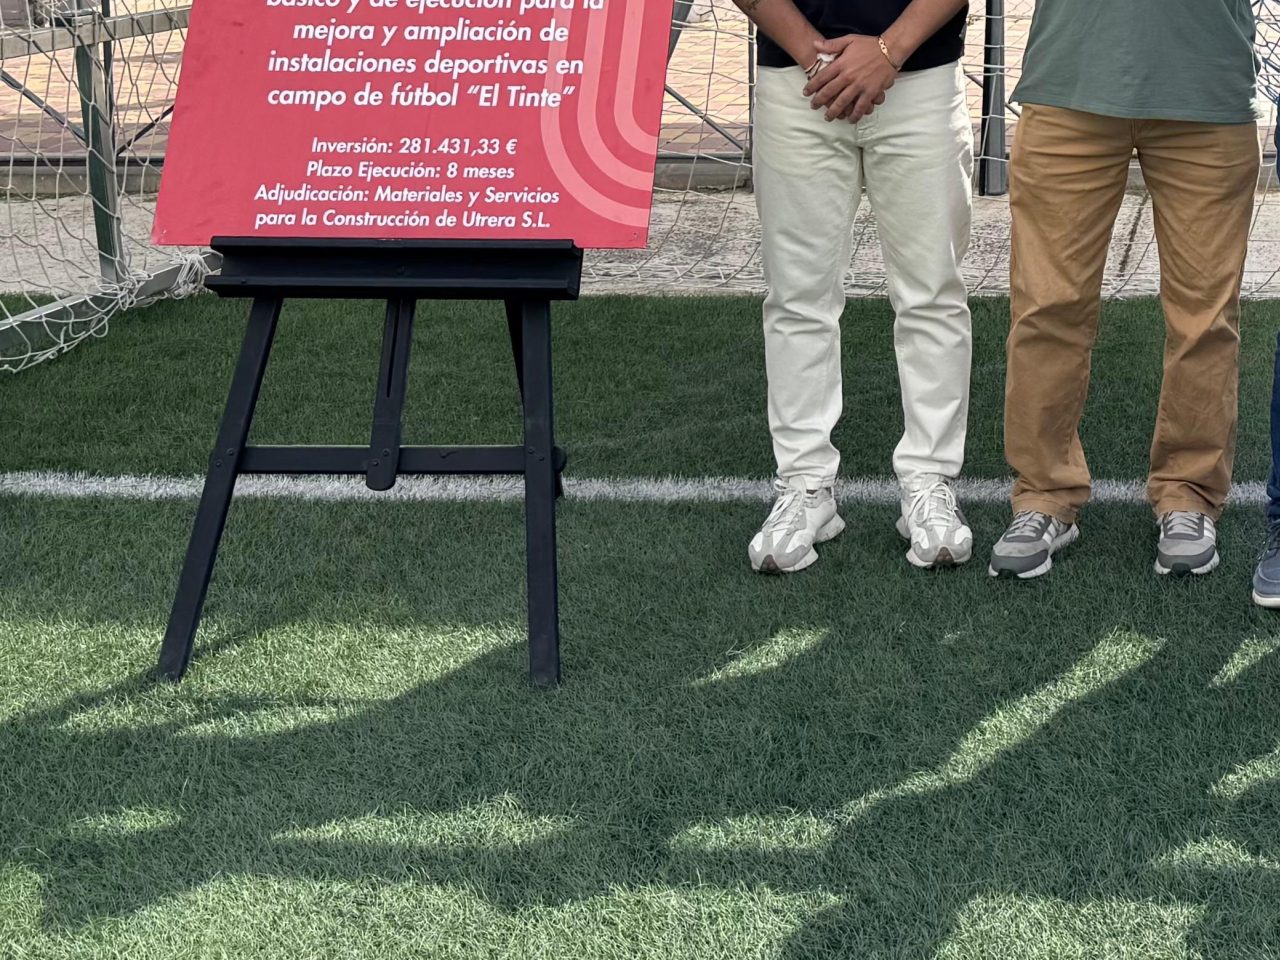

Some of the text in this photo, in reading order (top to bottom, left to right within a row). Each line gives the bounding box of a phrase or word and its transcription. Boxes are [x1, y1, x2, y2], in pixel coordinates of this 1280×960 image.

[293, 17, 569, 47] mejora y ampliación de
[268, 48, 584, 80] instalaciones deportivas en
[267, 89, 347, 111] campo
[353, 81, 383, 106] de
[390, 81, 459, 107] fútbol
[311, 137, 518, 157] Inversión: 281.431,33 €
[306, 159, 515, 182] Plazo Ejecución: 8 meses
[254, 183, 560, 208] Adjudicación: Materiales y Servicios
[254, 207, 550, 230] para la Construcción de Utrera S.L.
